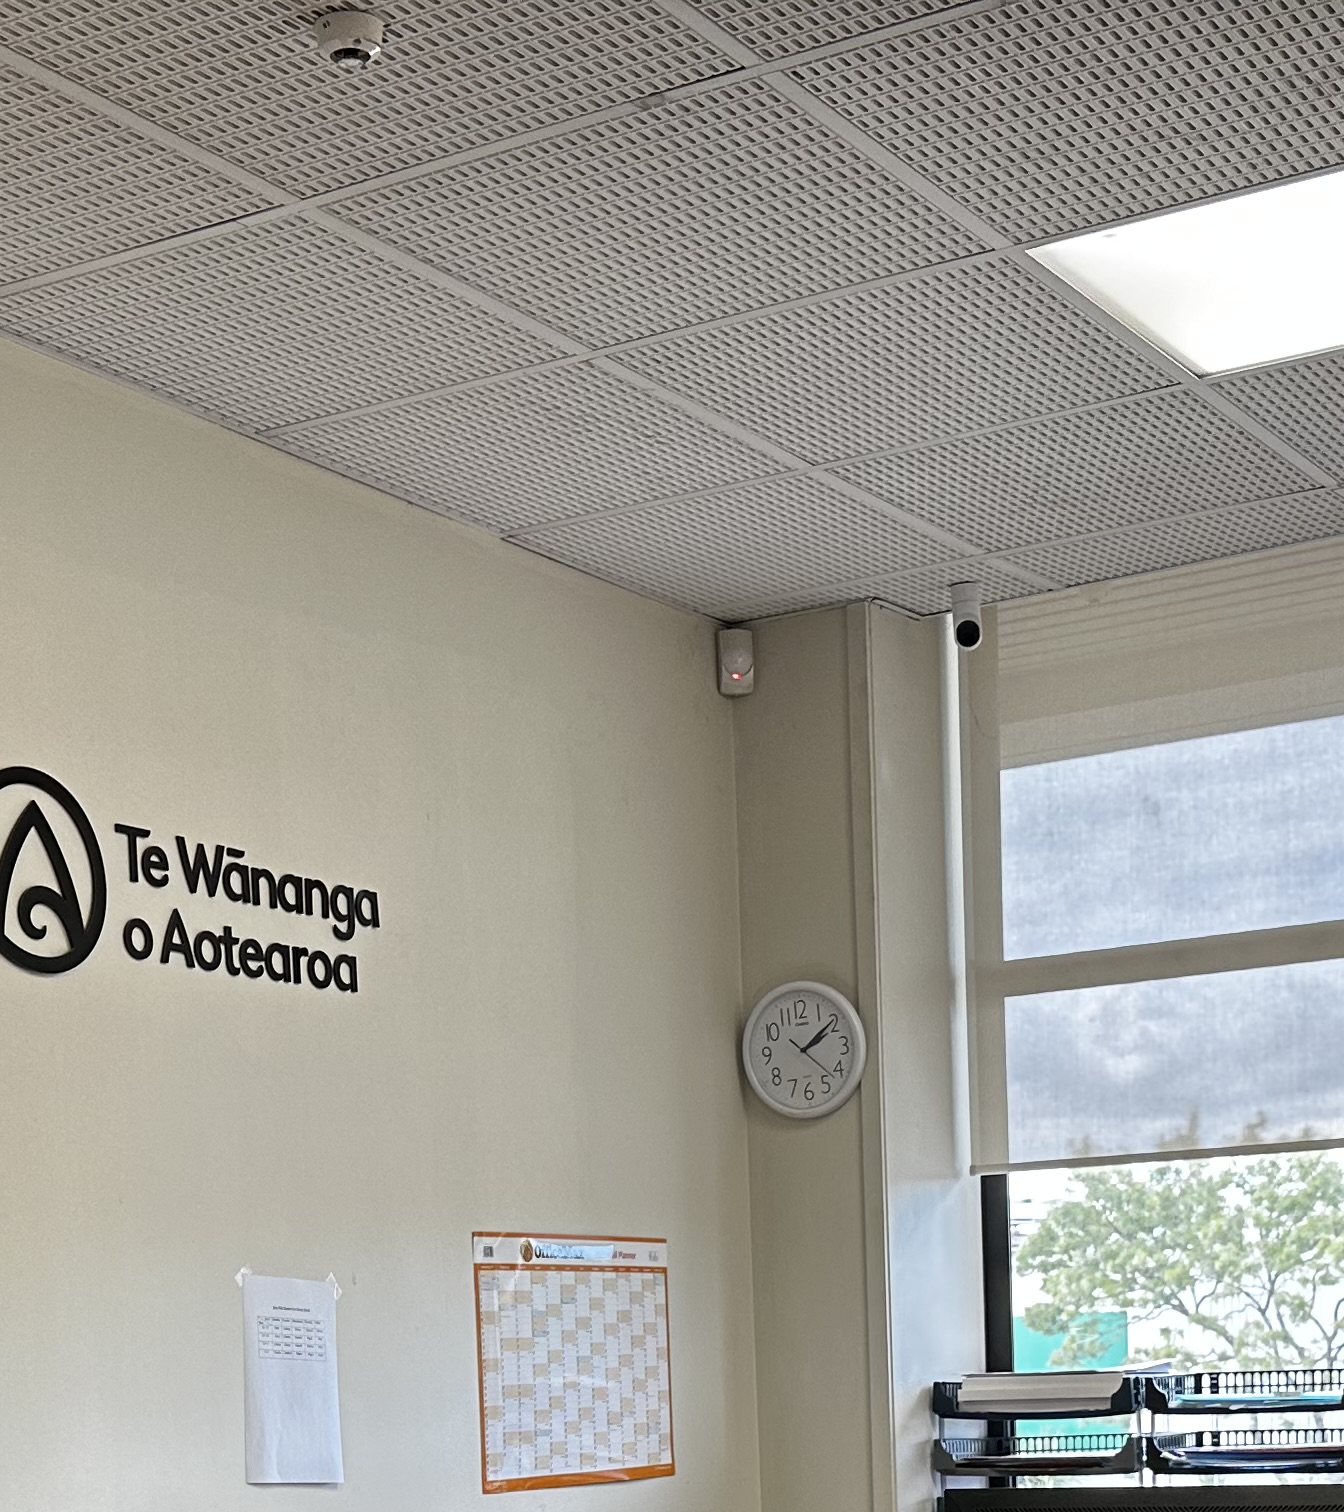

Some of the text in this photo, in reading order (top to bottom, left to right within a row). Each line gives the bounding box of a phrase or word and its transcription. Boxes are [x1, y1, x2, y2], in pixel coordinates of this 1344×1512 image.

[114, 823, 381, 941] Te Wānanga
[123, 908, 358, 993] o Aotearoa
[780, 1008, 791, 1027] 11
[794, 1000, 807, 1019] 12
[816, 1003, 821, 1022] 1
[766, 1022, 779, 1042] 10
[829, 1013, 839, 1033] 2
[838, 1036, 849, 1055] 3
[761, 1046, 772, 1066] 9
[771, 1067, 782, 1086] 8
[833, 1060, 844, 1078] 4
[787, 1079, 797, 1098] 7
[804, 1082, 814, 1100] 6
[821, 1074, 831, 1094] 5
